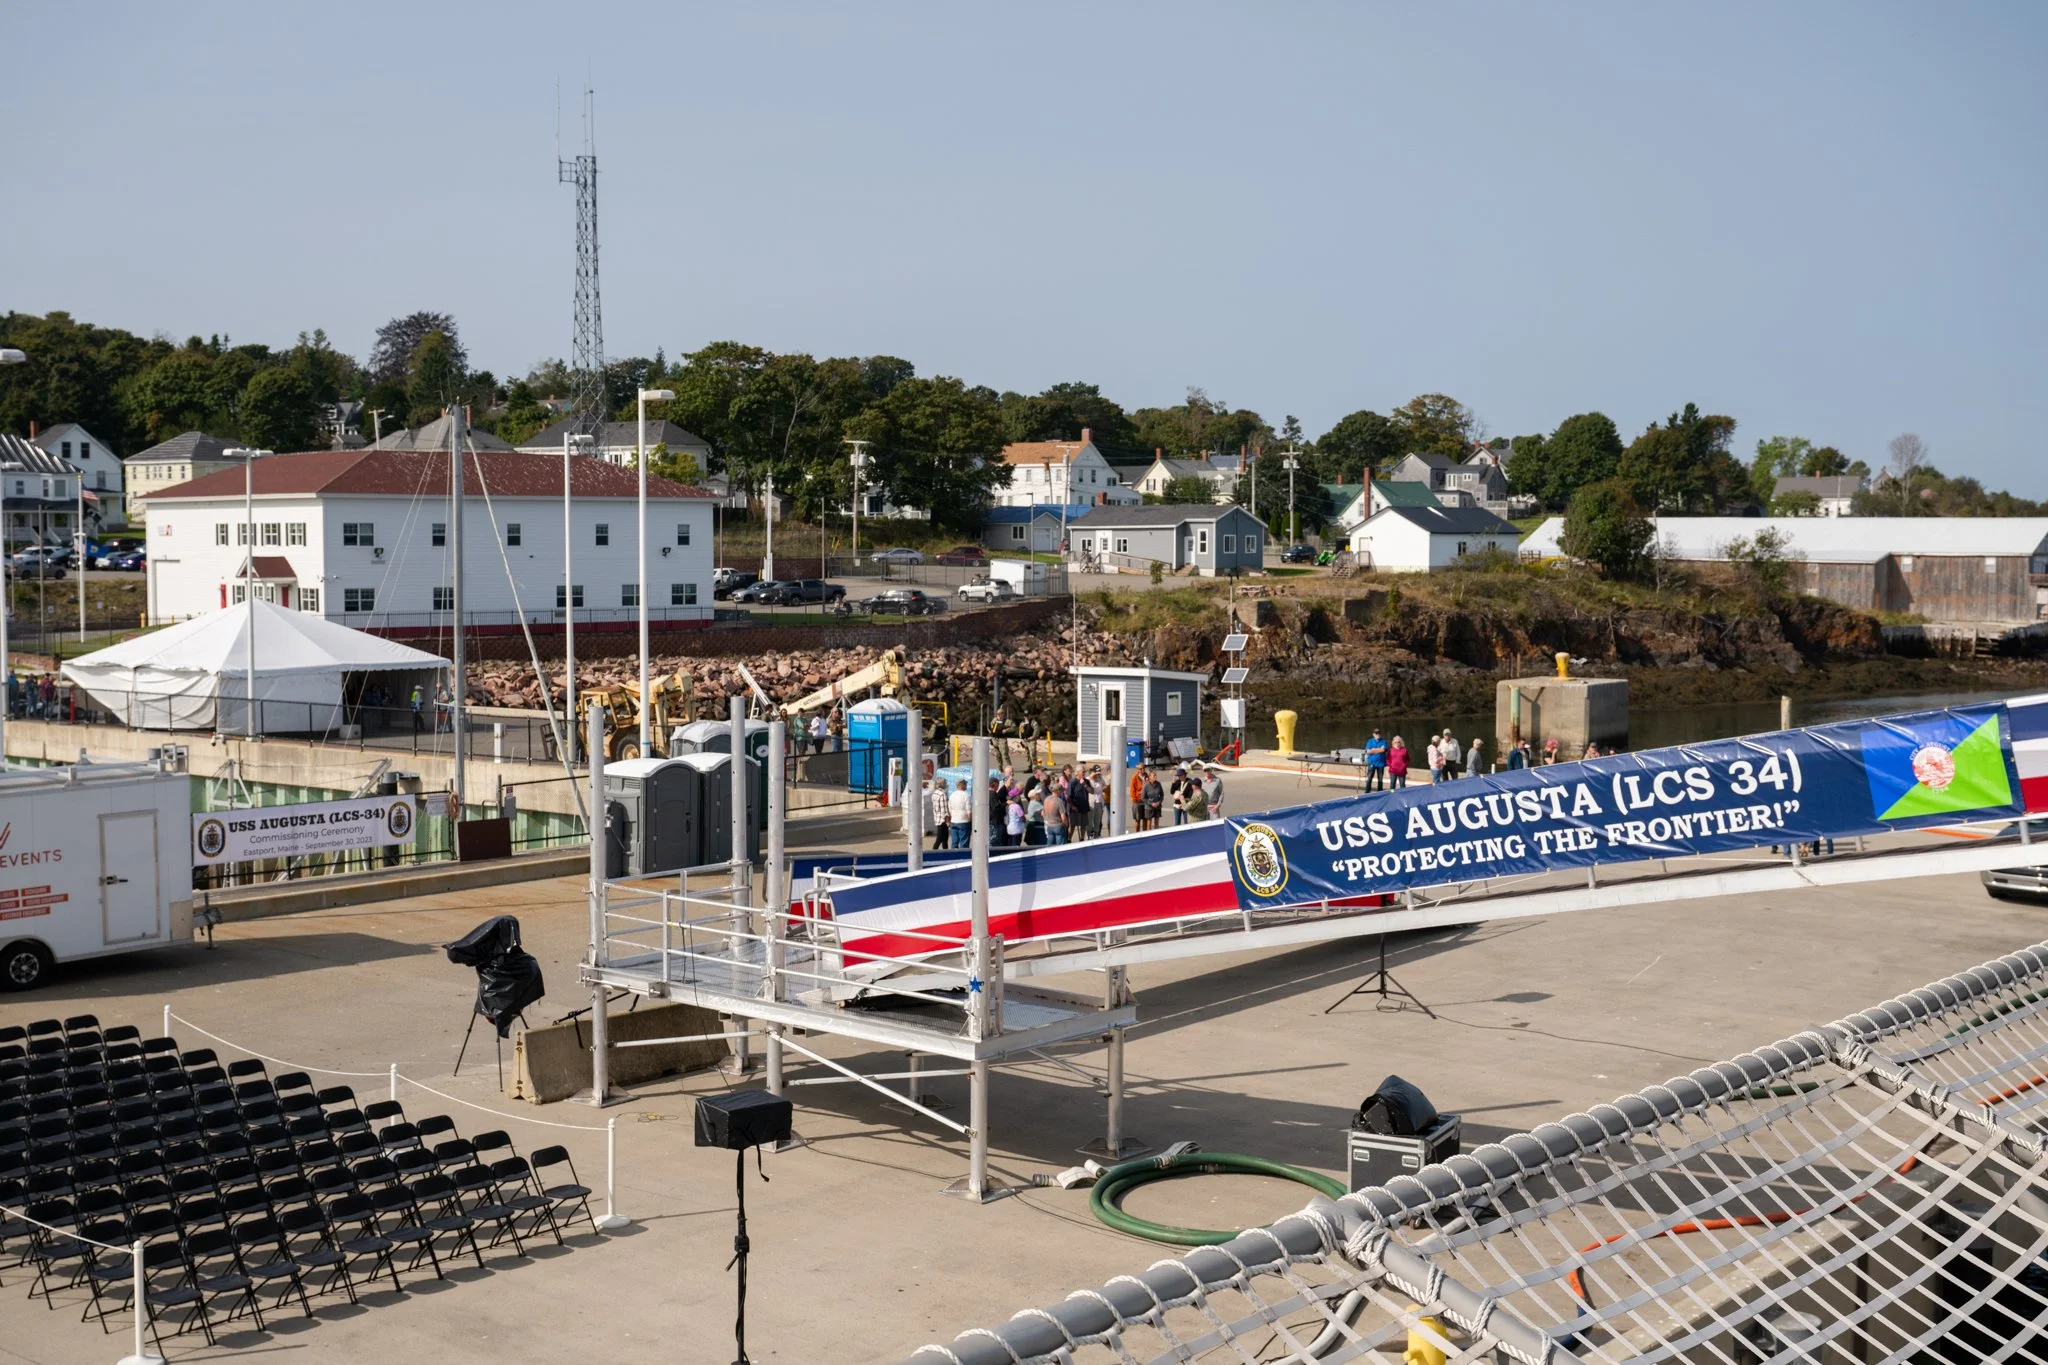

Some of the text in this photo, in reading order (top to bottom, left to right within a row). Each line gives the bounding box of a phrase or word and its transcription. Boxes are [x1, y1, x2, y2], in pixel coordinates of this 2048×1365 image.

[1316, 748, 1802, 851] USS AUGUSTA (LCS 34)
[229, 820, 256, 833] USS
[260, 813, 326, 829] AUGUSTA
[329, 808, 385, 824] (LCS-34)
[250, 826, 365, 843] Commissioning Ceremony
[1248, 826, 1275, 841] AUGUSTA
[1332, 799, 1800, 881] “PROTECTING THE FRONTIER!”
[278, 844, 299, 853] Maine
[305, 839, 343, 850] September
[357, 836, 373, 844] 2023
[0, 849, 62, 868] EVENTS
[1256, 884, 1280, 894] LCS 34
